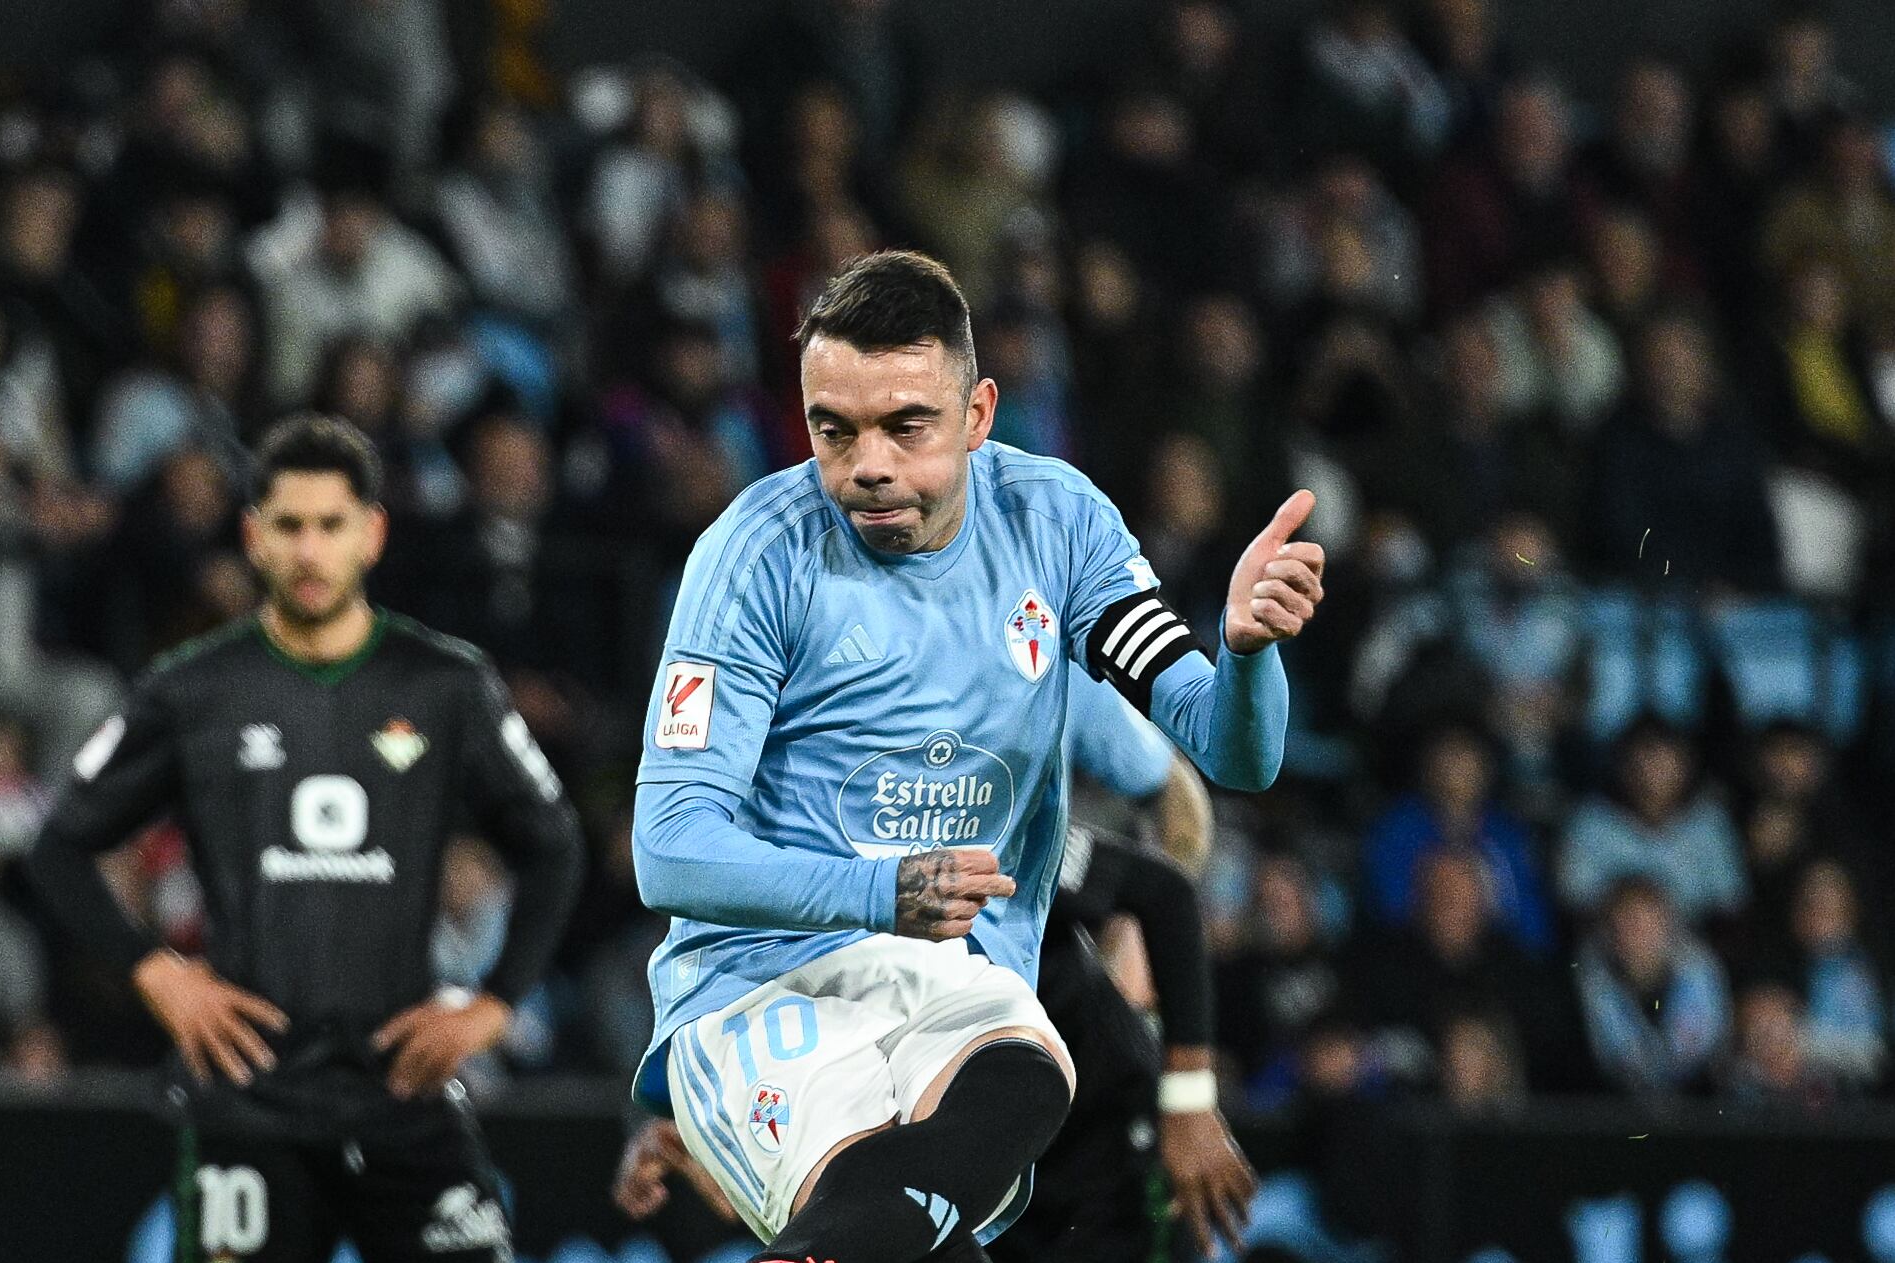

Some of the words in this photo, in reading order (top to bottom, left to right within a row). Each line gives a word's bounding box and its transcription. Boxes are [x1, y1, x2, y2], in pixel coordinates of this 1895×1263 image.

[662, 722, 699, 737] LAIGA
[870, 771, 994, 808] Estrella
[872, 806, 981, 842] Galicia
[721, 994, 820, 1088] 10
[196, 1165, 268, 1254] 10
